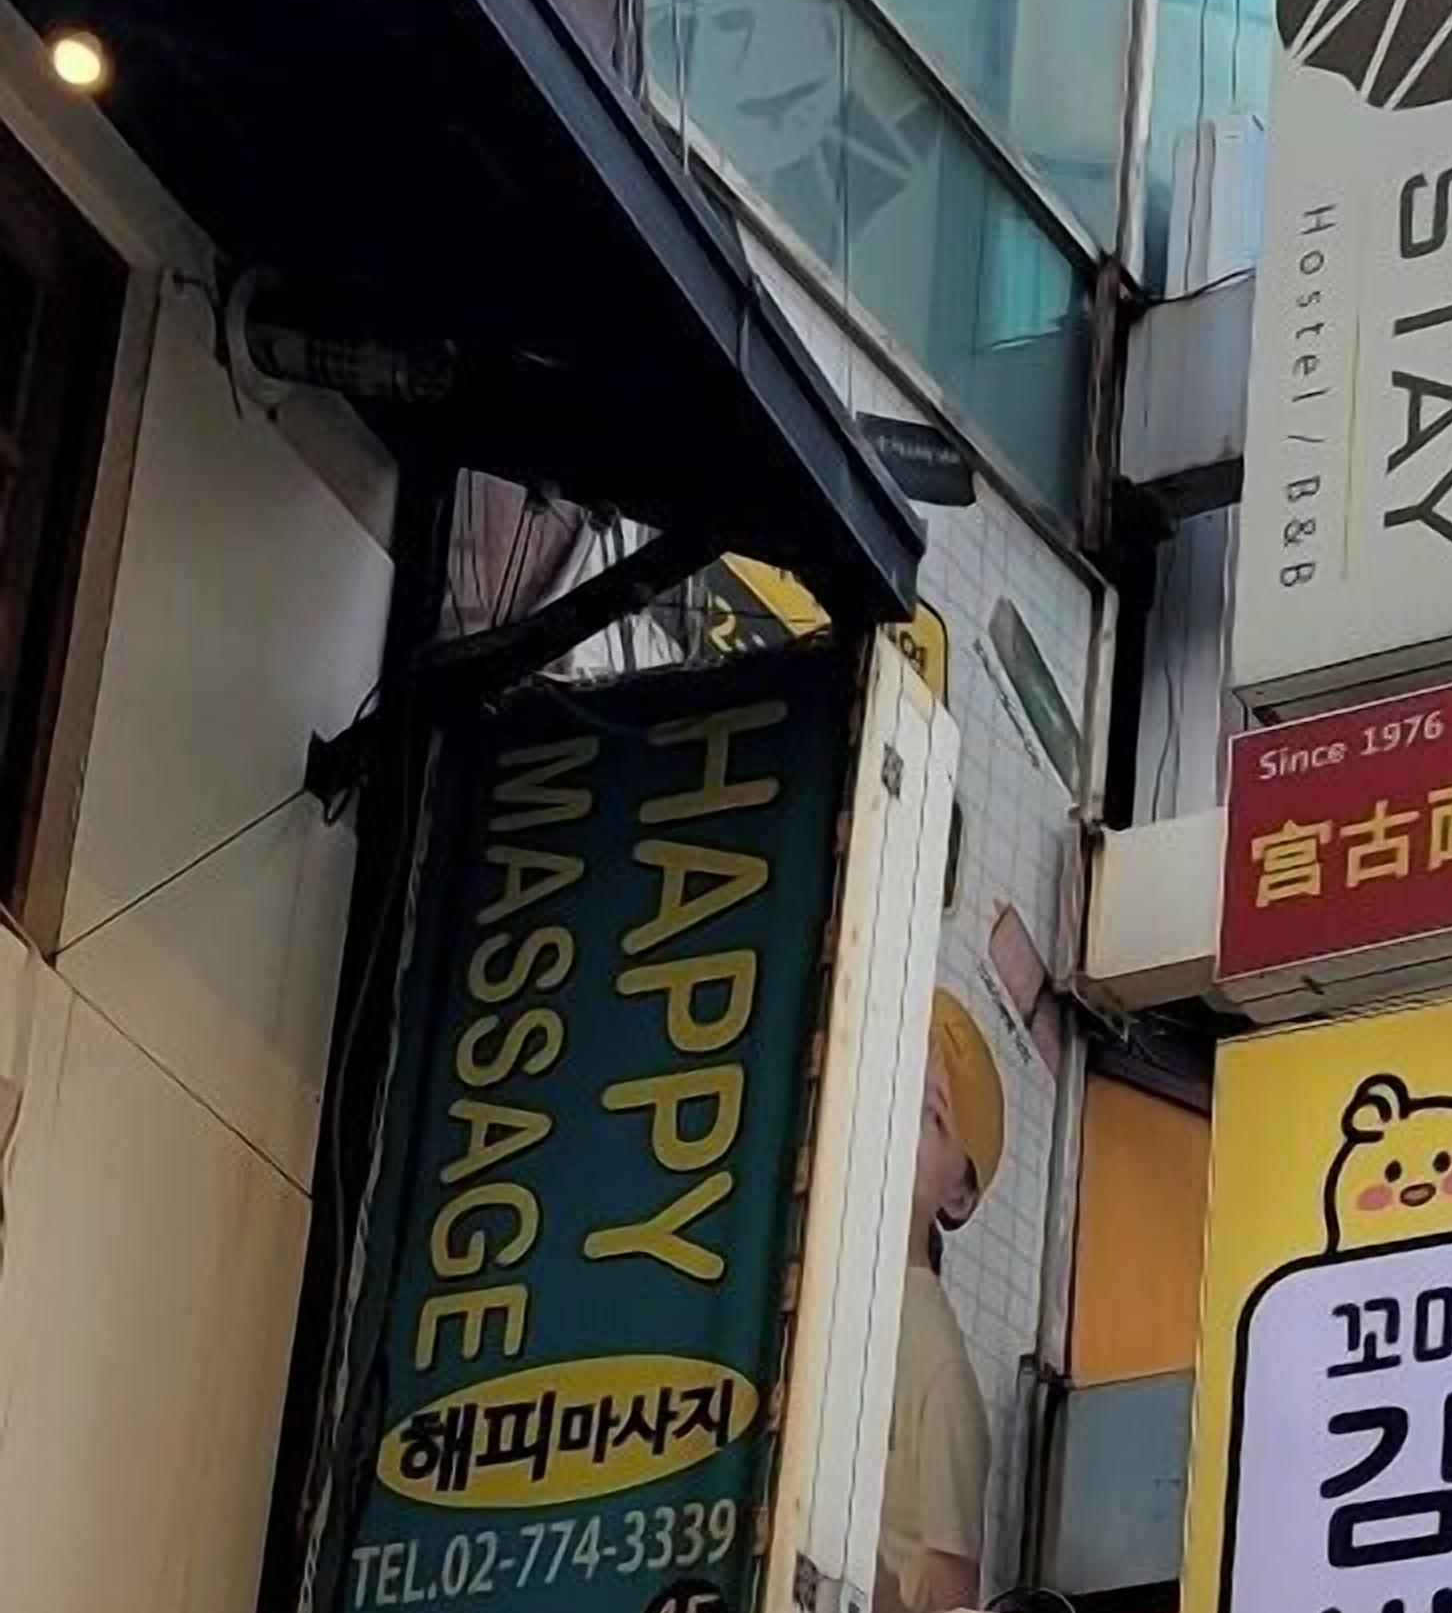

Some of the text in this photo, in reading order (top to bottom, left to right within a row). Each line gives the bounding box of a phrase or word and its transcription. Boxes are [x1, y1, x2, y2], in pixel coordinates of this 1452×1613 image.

[1292, 202, 1337, 404] Hostel
[1279, 479, 1318, 589] B&B
[1259, 711, 1444, 780] Since 1976
[584, 699, 788, 1281] HAPPY
[414, 737, 597, 1372] MASSAGE
[400, 1378, 735, 1494] 해피마사지
[351, 1500, 737, 1611] TEL.02-774-3339
